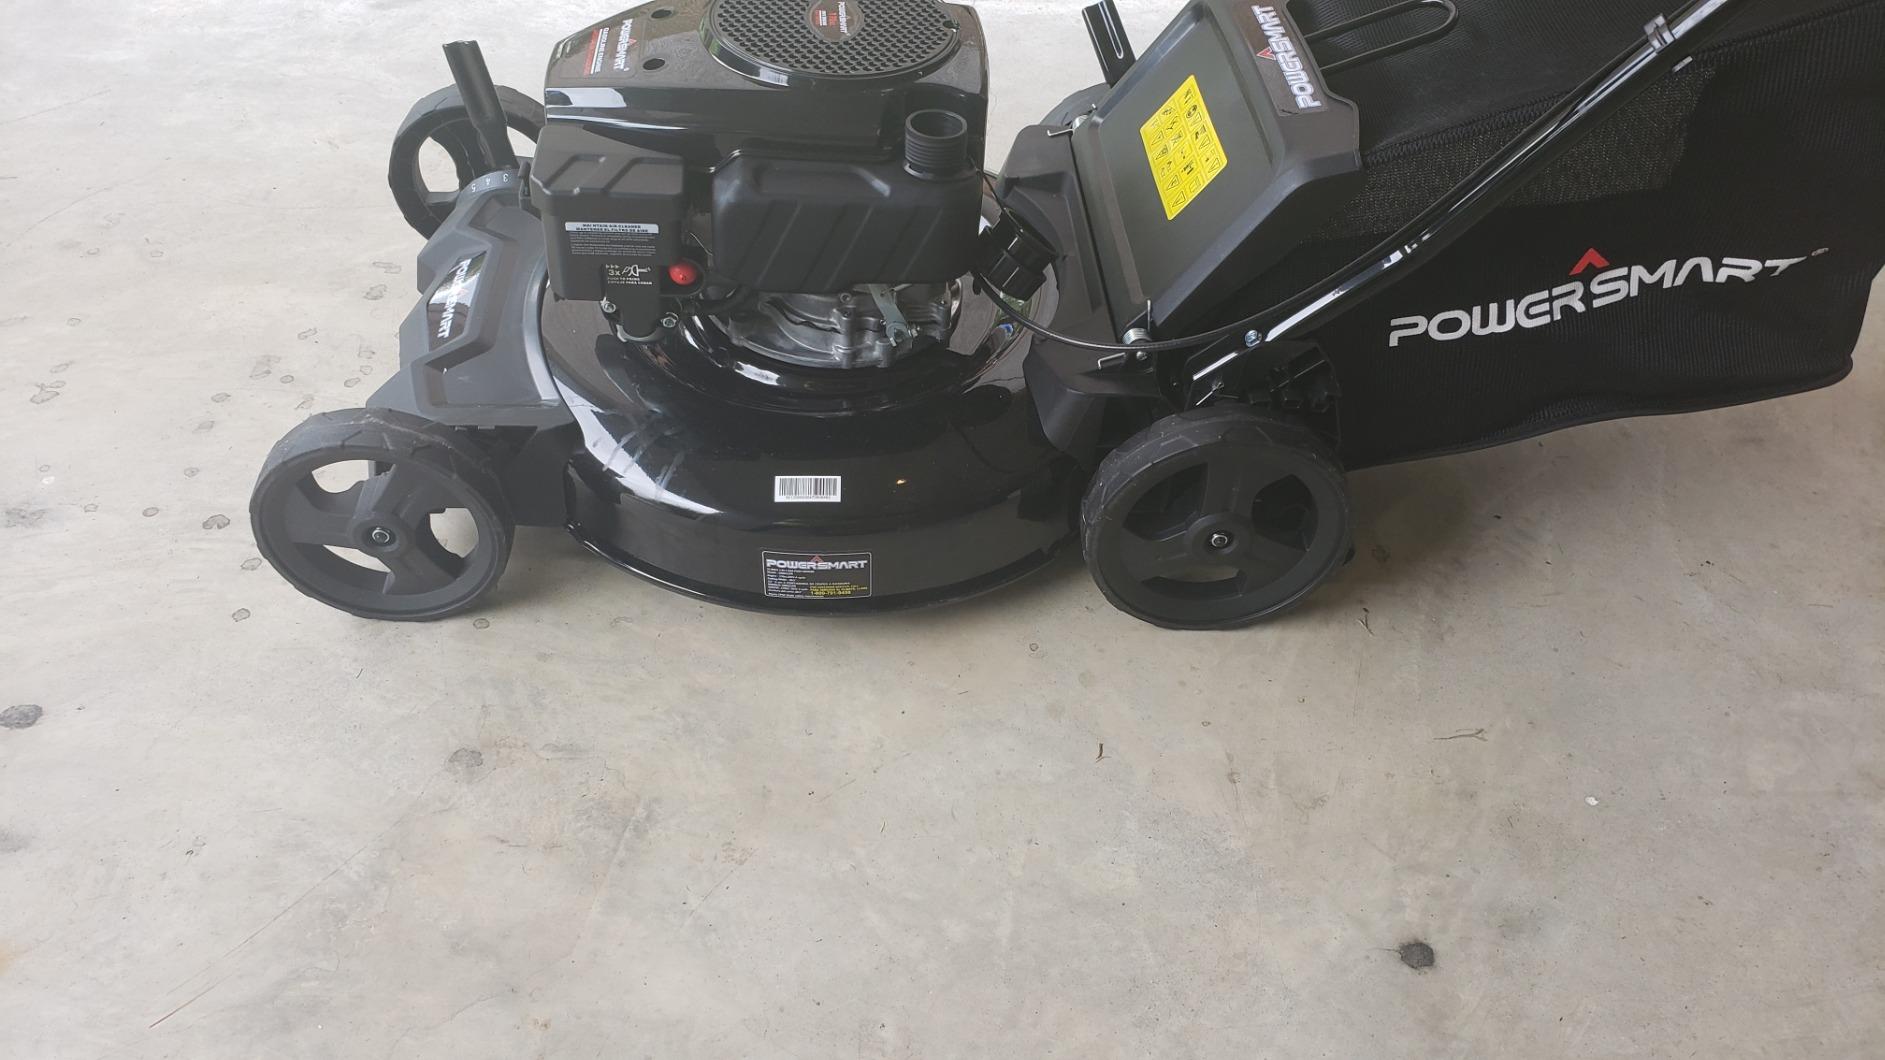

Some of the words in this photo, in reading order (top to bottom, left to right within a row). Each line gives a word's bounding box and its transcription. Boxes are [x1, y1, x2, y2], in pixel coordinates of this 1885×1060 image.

[613, 18, 633, 70] POWERSMART
[1251, 5, 1322, 109] POWERSMART
[437, 258, 472, 339] POWERSMART
[1388, 256, 1808, 347] POWERSMART
[766, 559, 868, 570] POWERSMART
